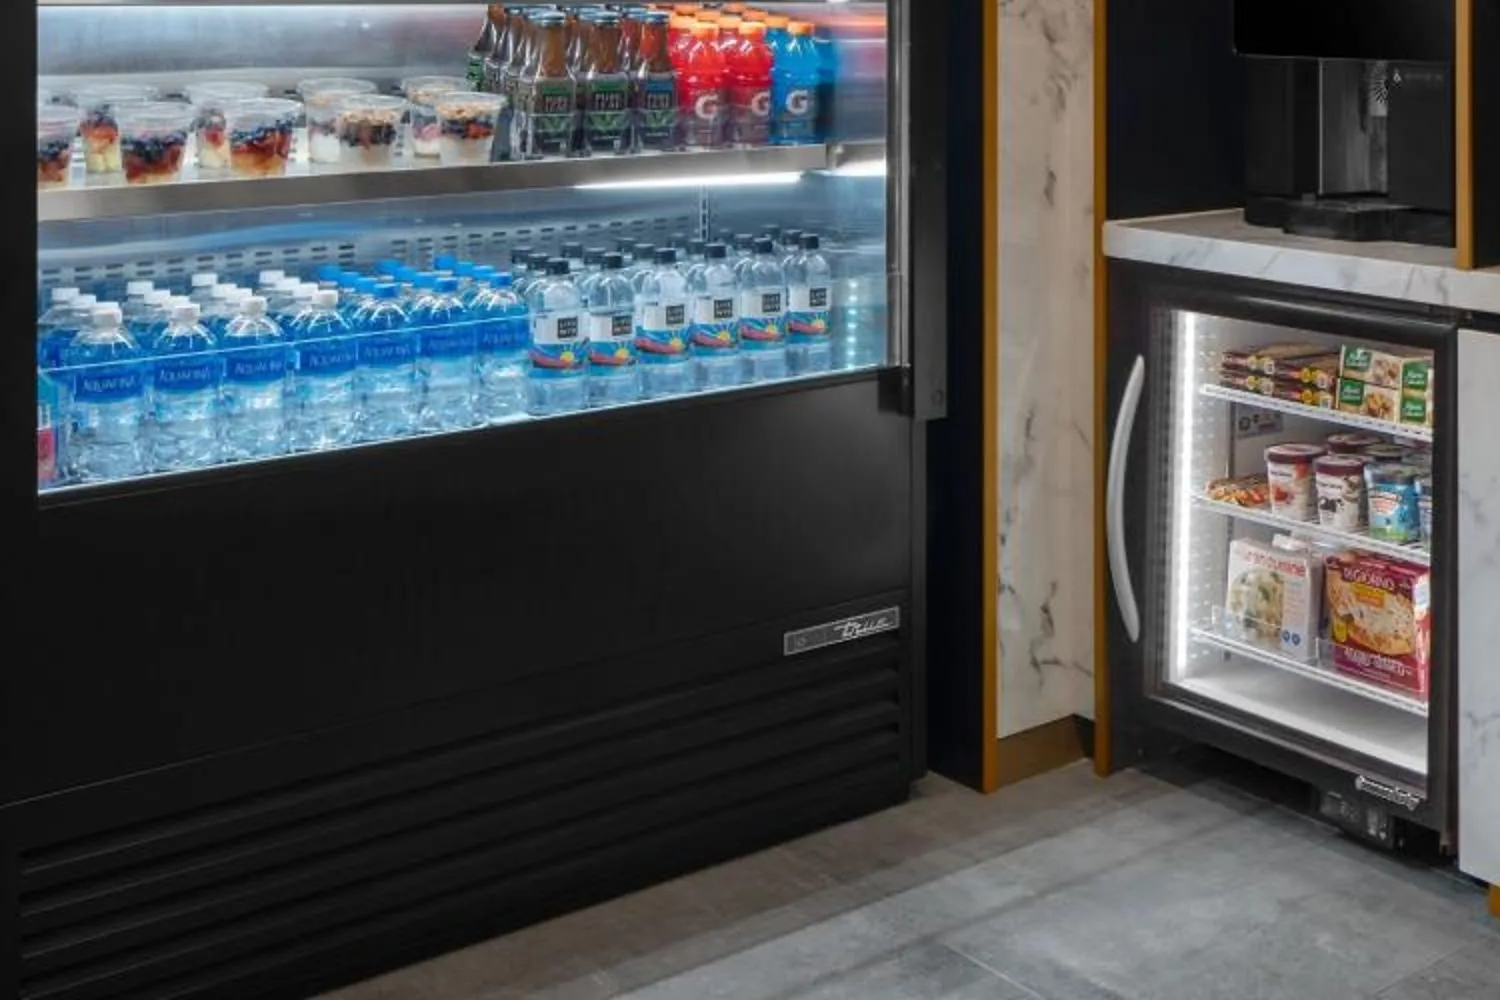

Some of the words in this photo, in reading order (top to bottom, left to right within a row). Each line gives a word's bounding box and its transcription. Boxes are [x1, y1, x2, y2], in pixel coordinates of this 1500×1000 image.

[694, 95, 719, 119] G
[751, 91, 771, 114] G
[785, 90, 808, 115] G
